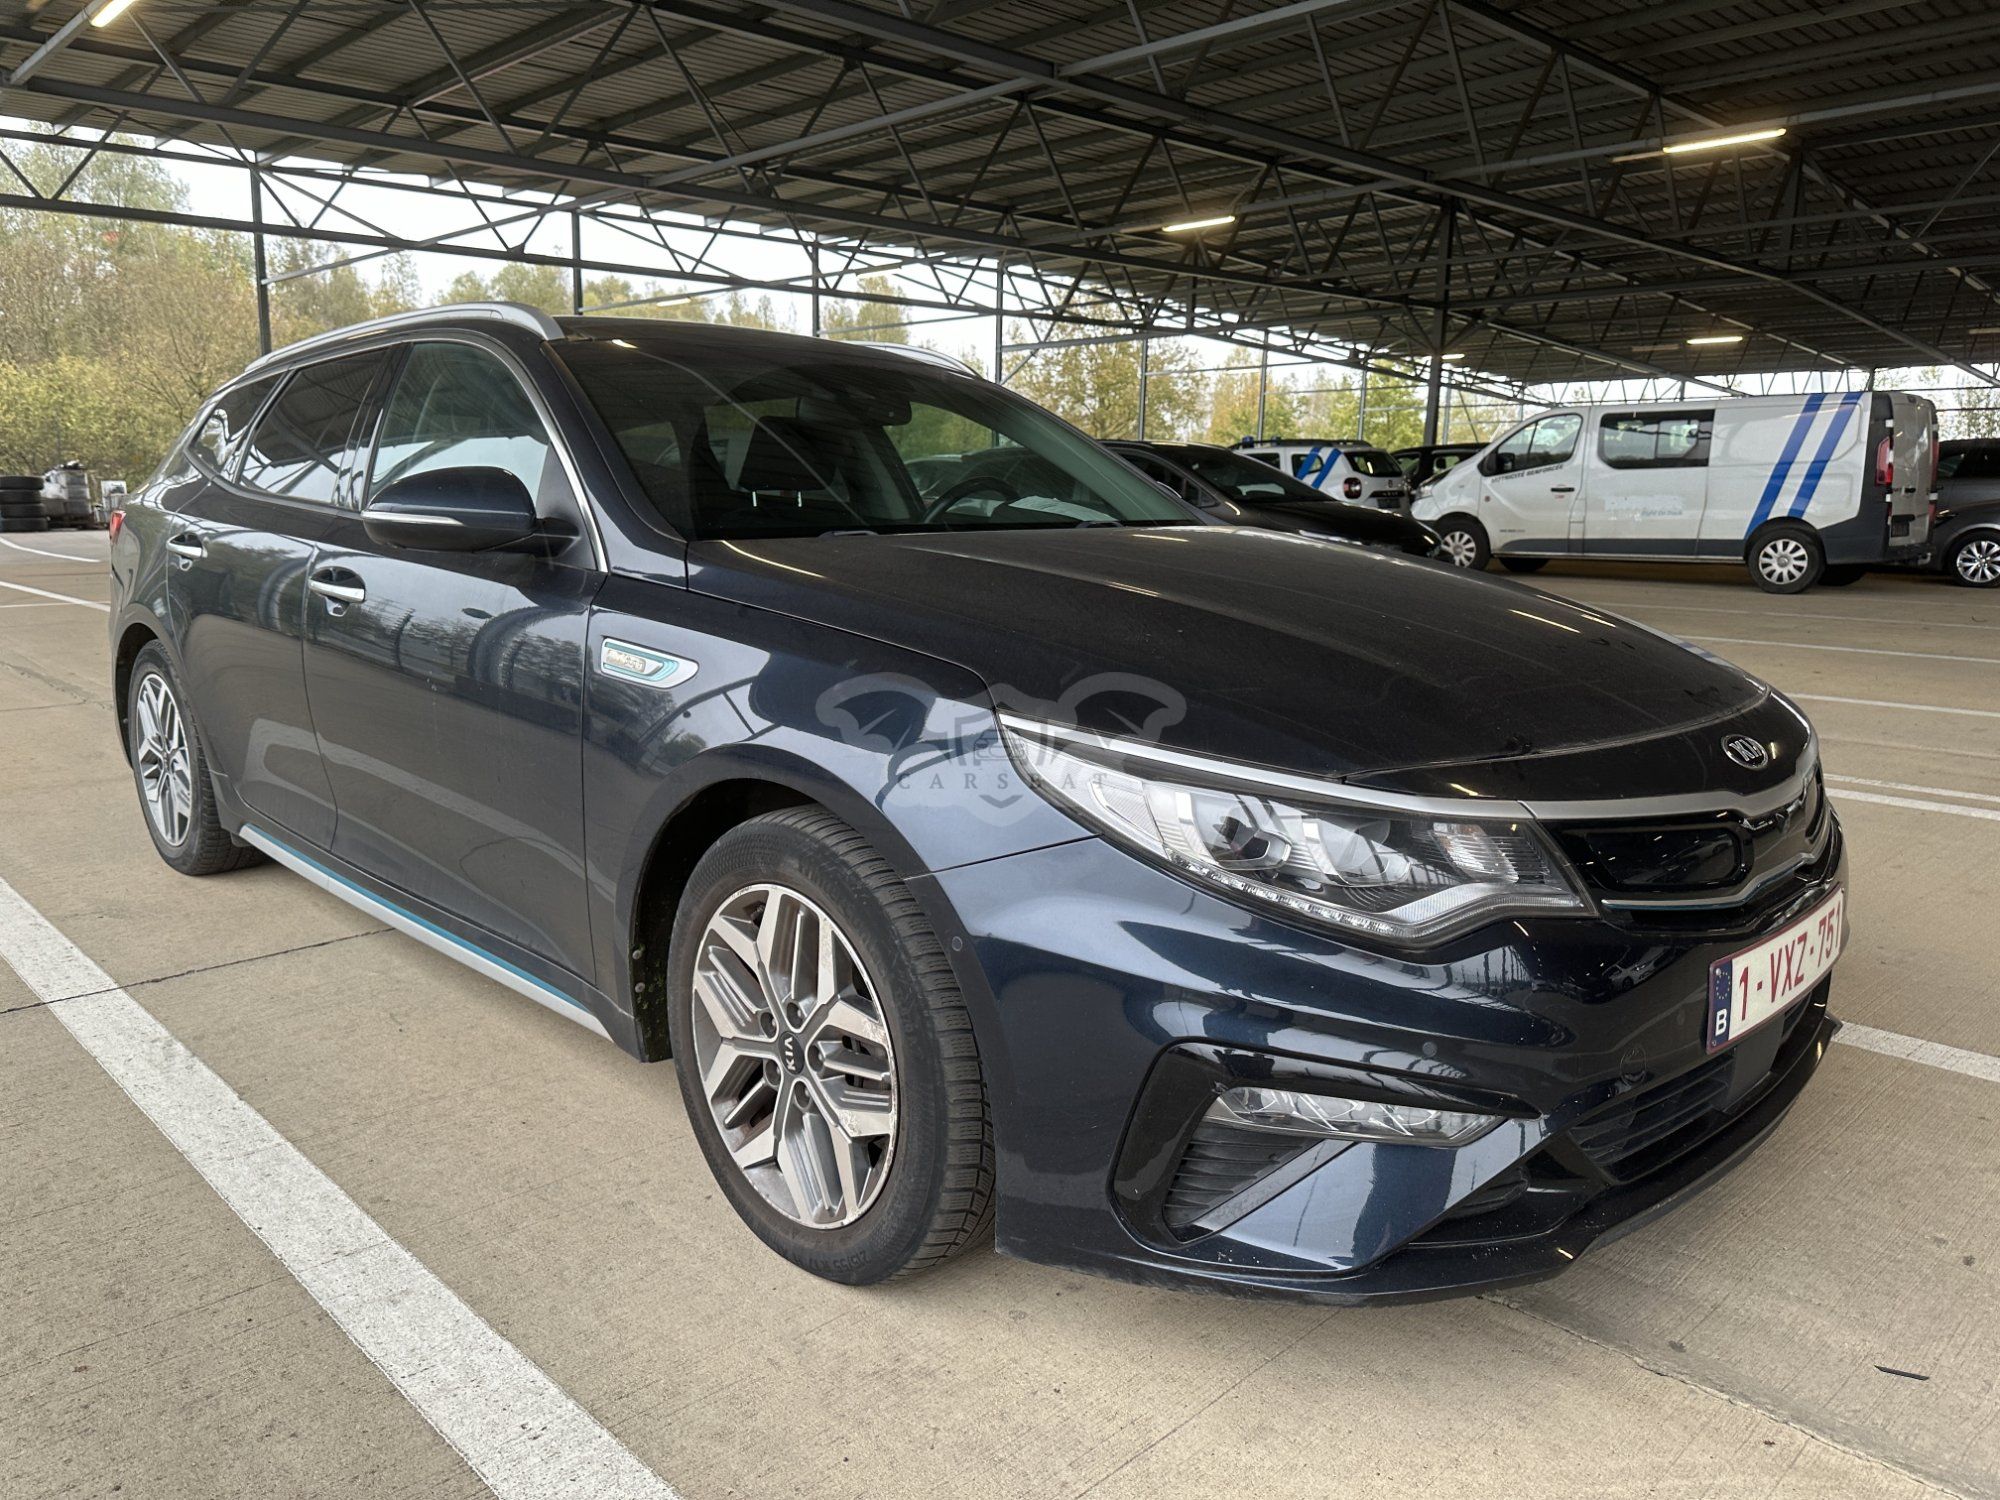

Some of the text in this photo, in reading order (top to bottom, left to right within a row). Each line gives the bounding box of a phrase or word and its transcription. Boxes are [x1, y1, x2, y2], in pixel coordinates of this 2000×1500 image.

[1739, 900, 1841, 1022] 1-VXZ-751
[1715, 1008, 1728, 1037] B
[784, 1036, 797, 1071] KIA
